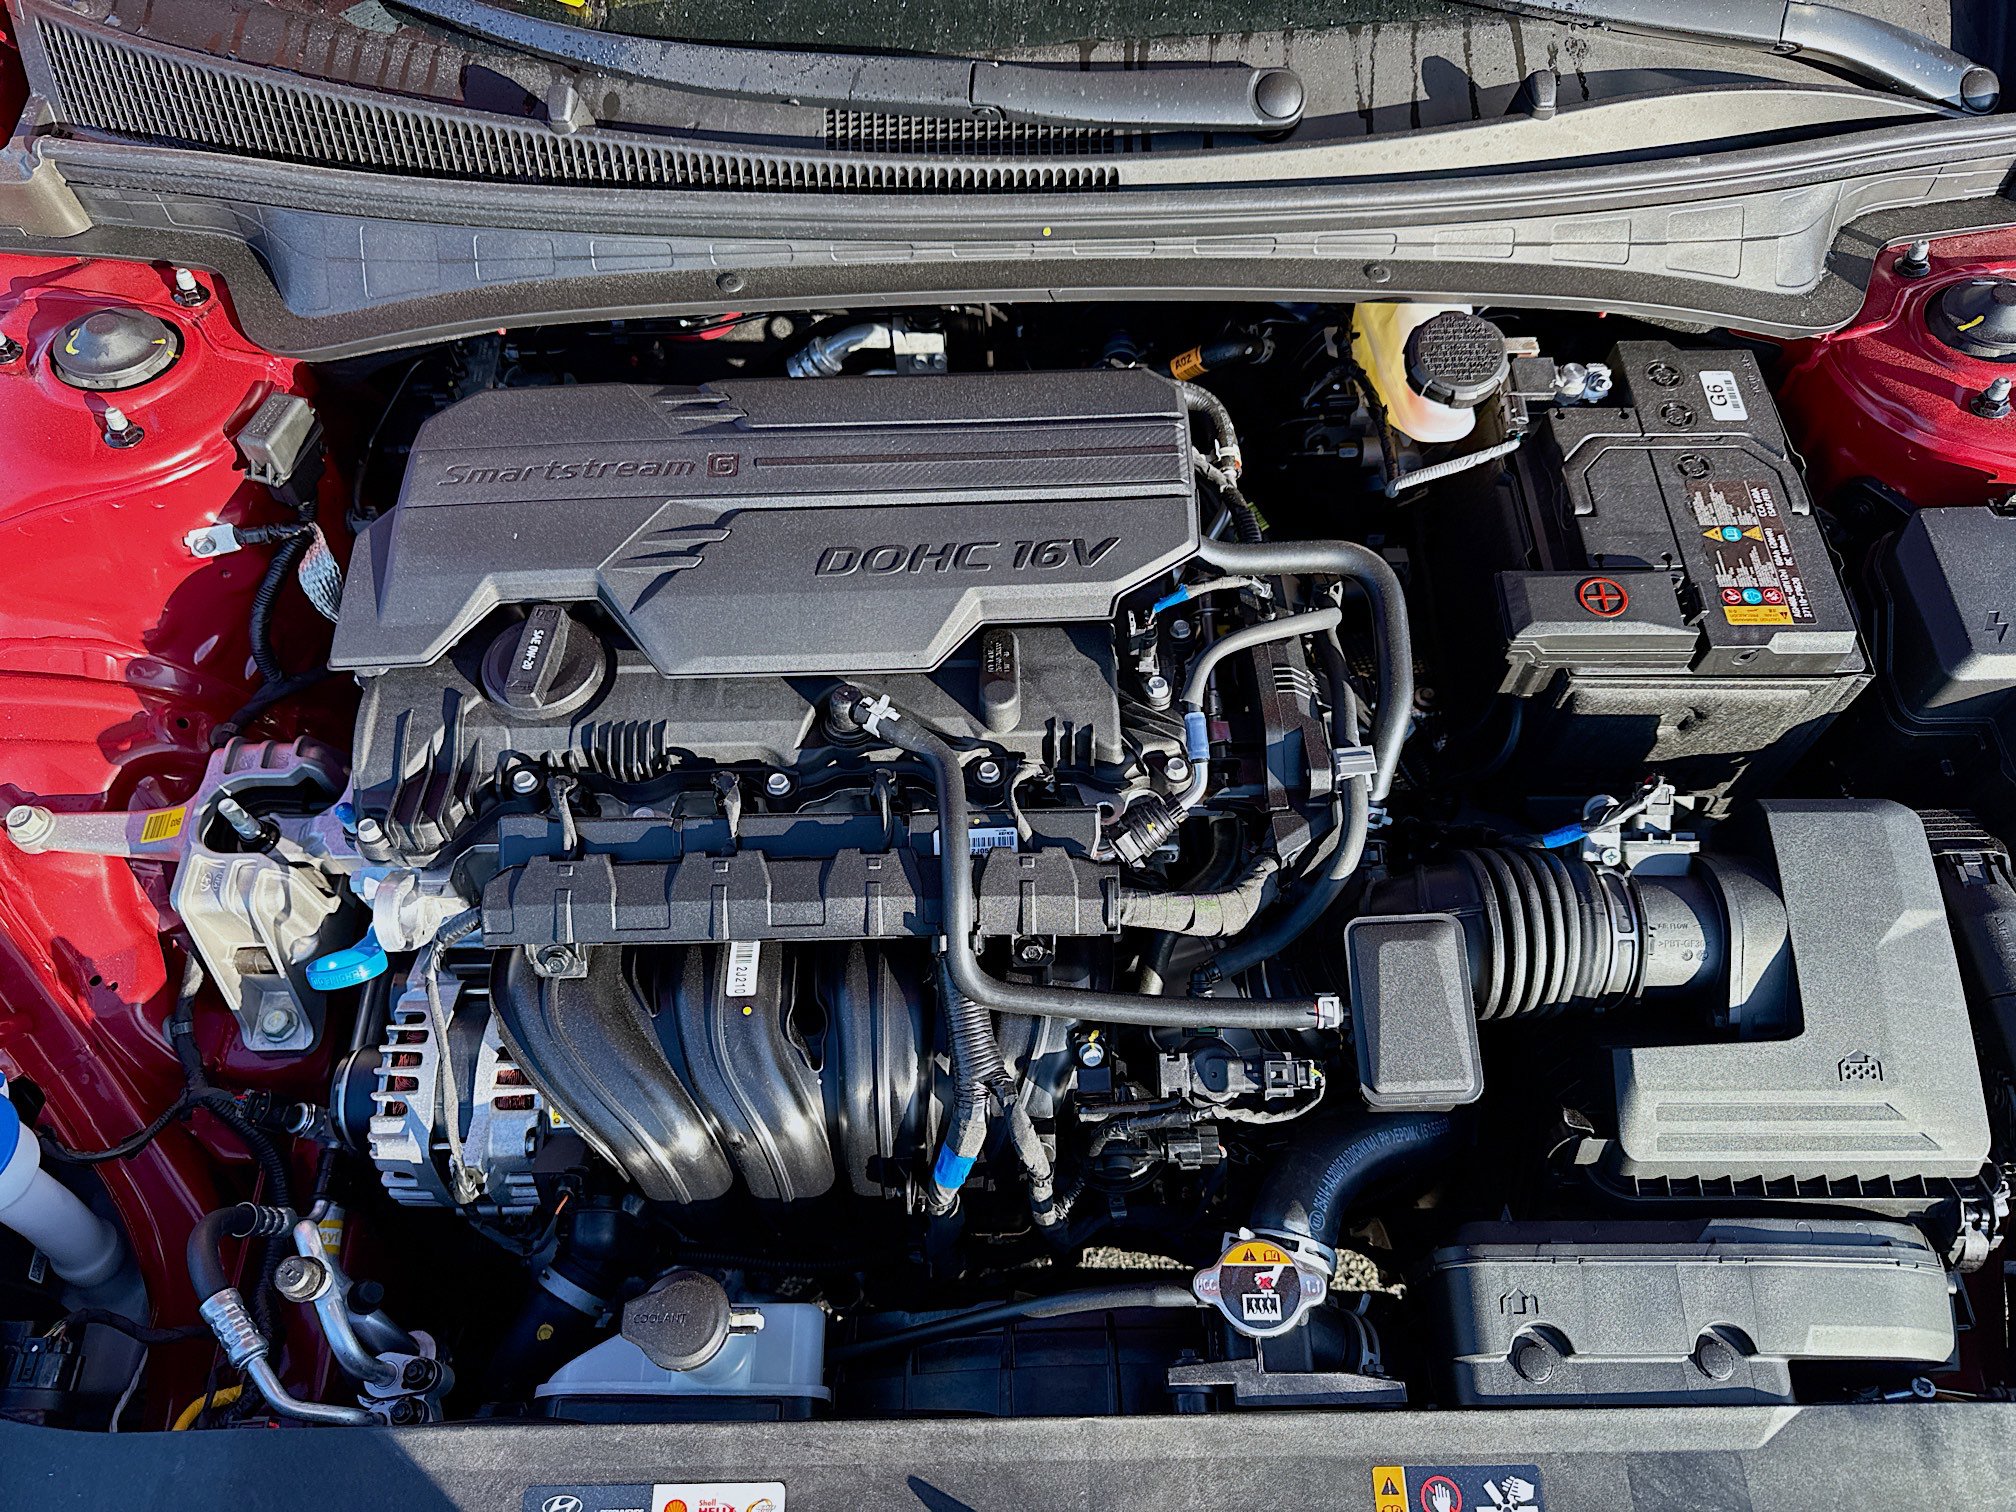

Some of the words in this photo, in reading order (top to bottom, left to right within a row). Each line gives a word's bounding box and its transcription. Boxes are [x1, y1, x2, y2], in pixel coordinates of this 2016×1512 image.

[1175, 354, 1192, 370] A02
[1706, 384, 1728, 406] G6
[437, 458, 697, 486] Smartstream
[1756, 504, 1767, 517] CCA
[815, 541, 1001, 577] DOHC
[1012, 537, 1122, 571] 16V
[1783, 556, 1794, 567] RC
[530, 629, 545, 645] SAE
[521, 645, 539, 671] 0W-20
[734, 966, 748, 994] 2J210
[1377, 1130, 1391, 1147] PH
[1196, 1279, 1218, 1291] HCC
[1306, 1280, 1321, 1293] 1.1
[633, 1312, 687, 1324] COOLANT
[699, 1498, 717, 1507] Shell
